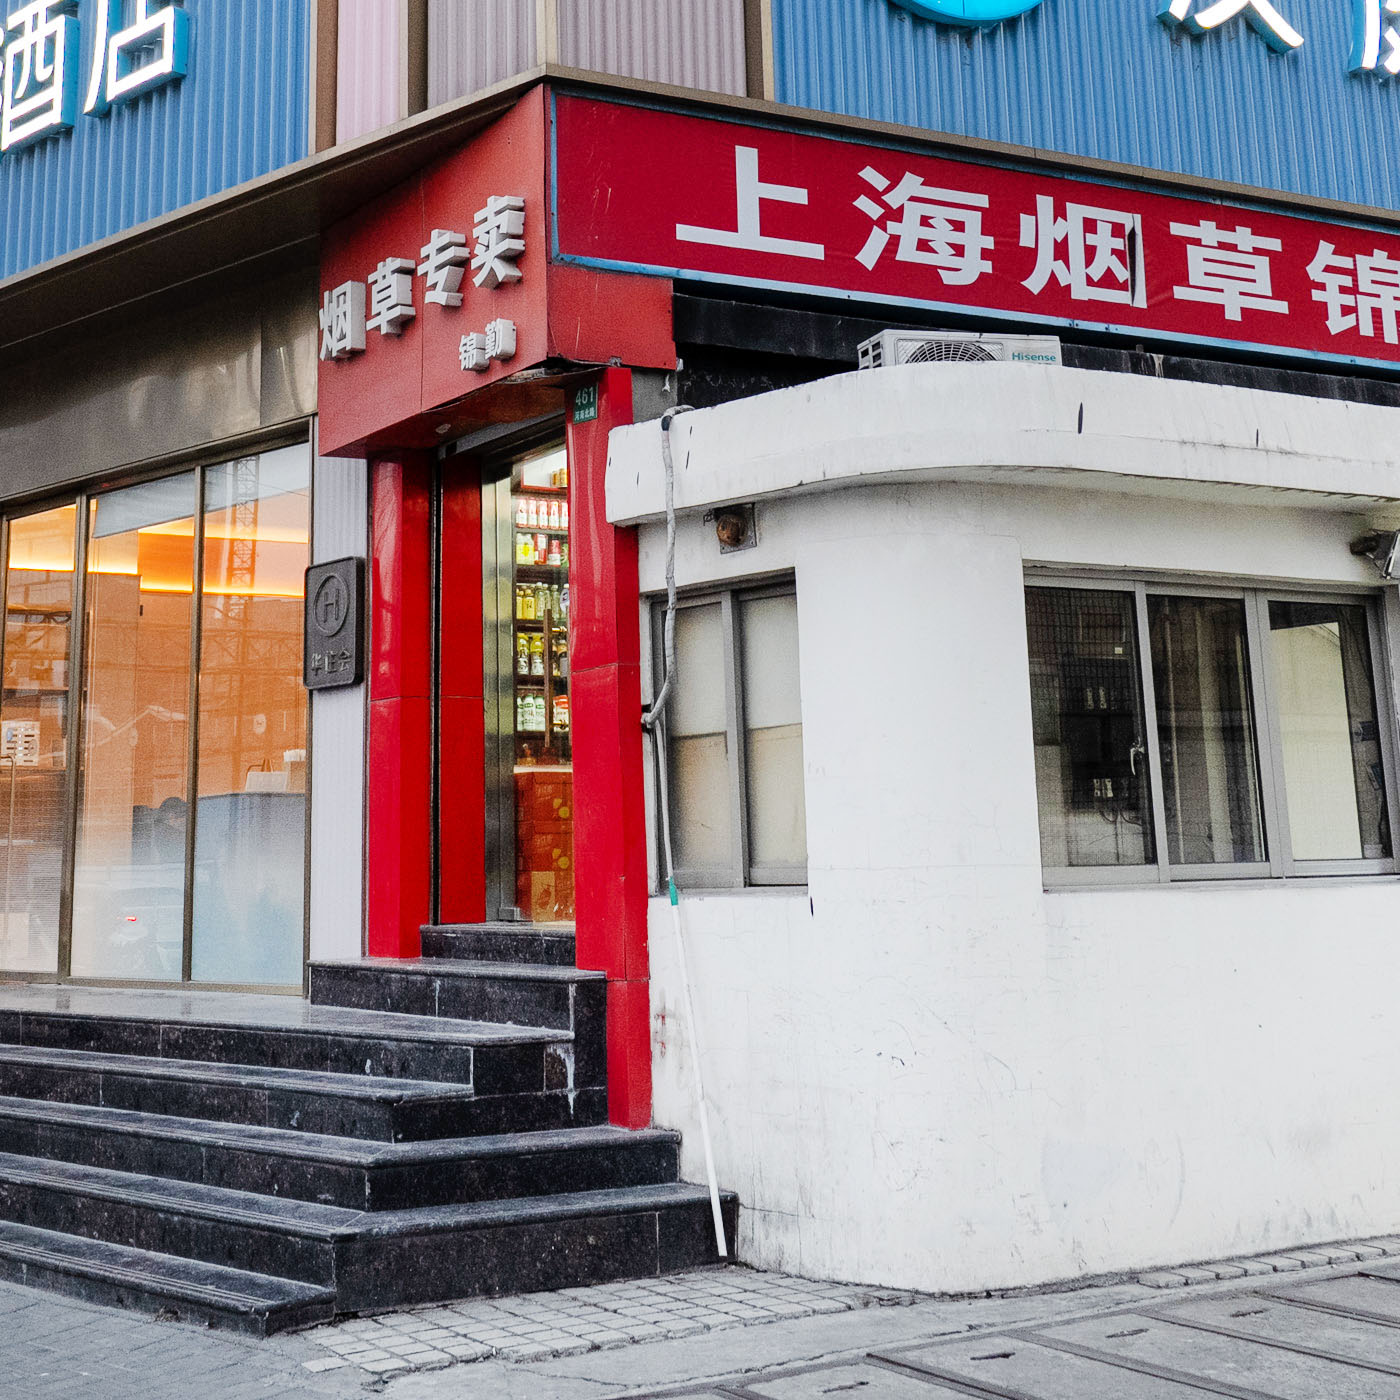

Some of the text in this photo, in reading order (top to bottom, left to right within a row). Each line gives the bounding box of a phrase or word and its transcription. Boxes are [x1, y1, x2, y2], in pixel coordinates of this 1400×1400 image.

[319, 195, 525, 361] 烟草专卖
[1012, 352, 1057, 361] Hisense
[575, 386, 594, 406] 461
